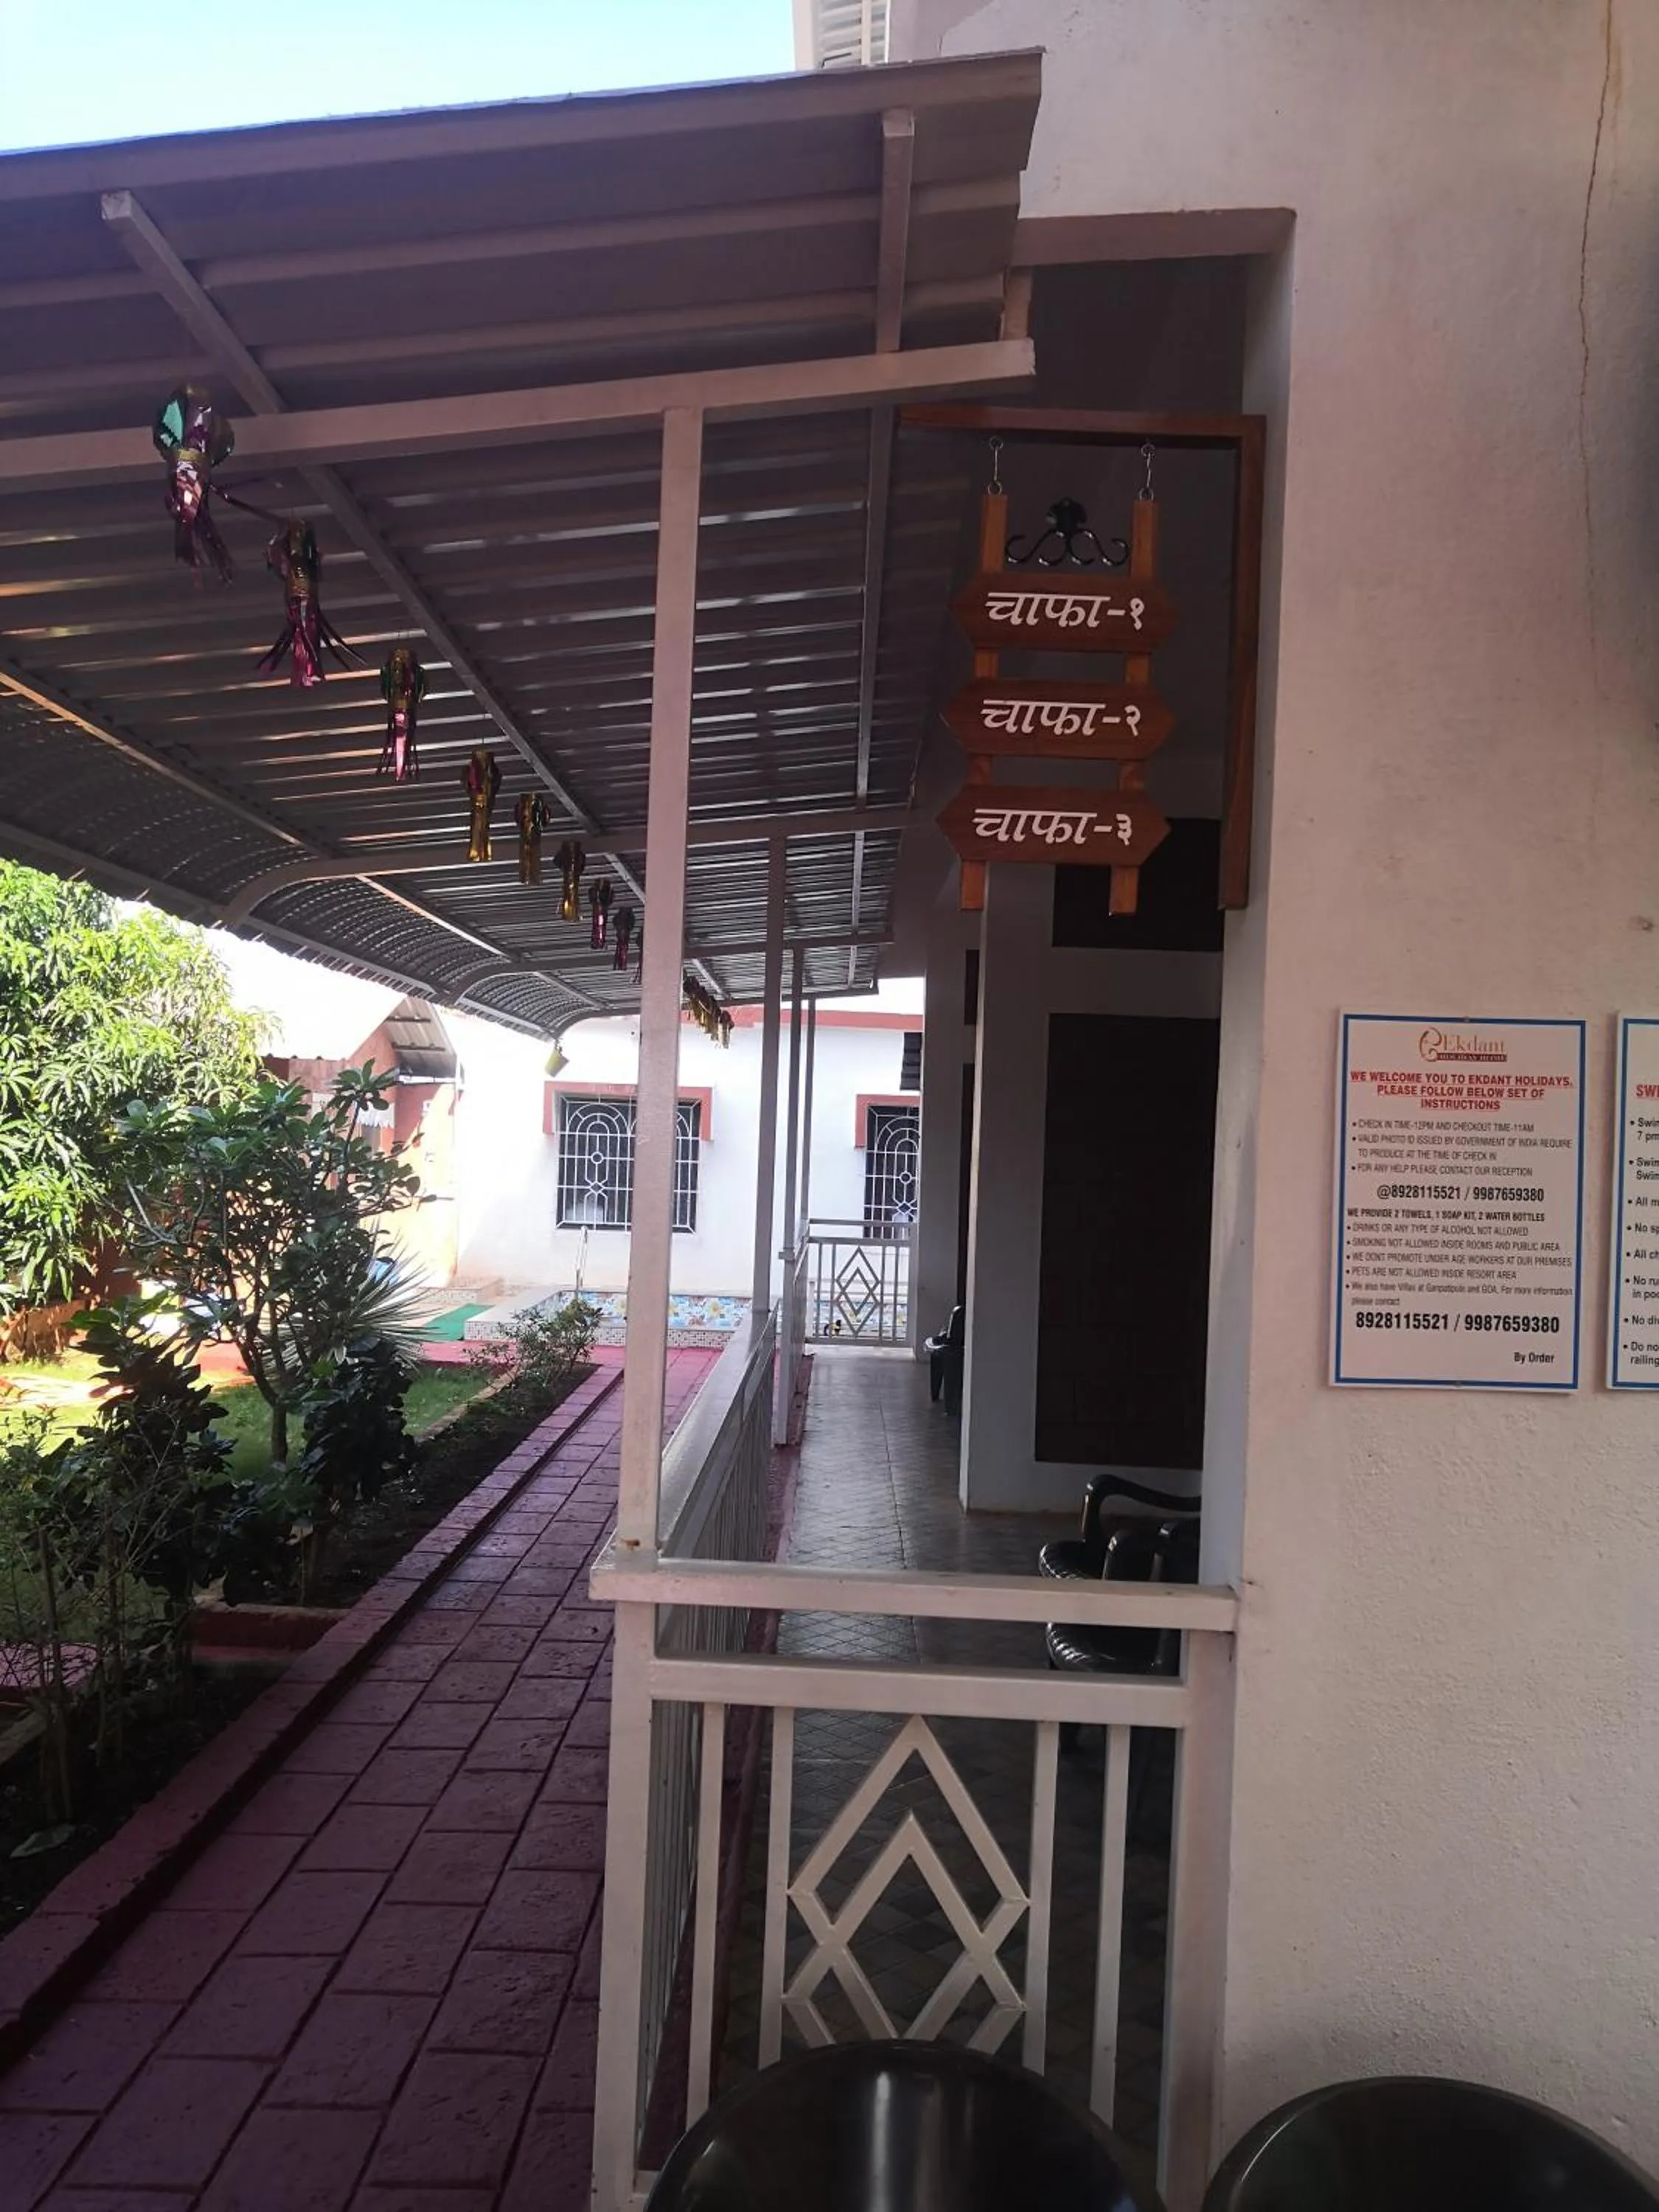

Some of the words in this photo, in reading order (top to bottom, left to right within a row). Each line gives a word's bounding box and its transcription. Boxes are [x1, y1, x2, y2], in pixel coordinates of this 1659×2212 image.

[985, 592, 1145, 630] चाफा-१
[980, 700, 1141, 736] चाफा-२
[972, 808, 1133, 846] चाफा-३
[1351, 1071, 1366, 1081] WE
[1370, 1072, 1422, 1082] WELCOME
[1425, 1074, 1447, 1084] YOU
[1451, 1074, 1465, 1084] TO
[1469, 1075, 1512, 1085] EKDANT
[1515, 1076, 1573, 1086] HOLIDAYS.
[1377, 1085, 1417, 1095] PLEASE
[1421, 1086, 1464, 1096] FOLLOW
[1467, 1088, 1504, 1097] BELOW
[1507, 1088, 1527, 1098] SET
[1531, 1089, 1545, 1099] OF
[1422, 1099, 1500, 1110] INSTRUCTIONS
[1358, 1119, 1382, 1128] CHECK
[1385, 1120, 1393, 1129] IN
[1436, 1121, 1451, 1130] AND
[1453, 1121, 1492, 1132] CHECKOUT
[1494, 1123, 1534, 1133] TIME-11AM
[1358, 1134, 1379, 1143] VALID
[1381, 1135, 1405, 1144] PHOTO
[1408, 1135, 1415, 1144] ID
[1416, 1135, 1442, 1144] ISSUED
[1445, 1136, 1454, 1145] BY
[1455, 1136, 1505, 1147] GOVERNMENT
[1508, 1138, 1518, 1147] OF
[1519, 1138, 1539, 1147] INDIA
[1540, 1138, 1572, 1148] REQUIRE
[1358, 1148, 1368, 1158] TO
[1370, 1149, 1404, 1158] PRODUCE
[1407, 1150, 1416, 1158] AT
[1418, 1150, 1431, 1159] THE
[1433, 1150, 1449, 1159] TIME
[1452, 1150, 1461, 1160] OF
[1463, 1151, 1486, 1161] CHECK
[1489, 1152, 1496, 1161] IN
[1358, 1163, 1371, 1172] FOR
[1374, 1164, 1388, 1172] ANY
[1391, 1164, 1409, 1173] HELP
[1411, 1165, 1437, 1174] PLEASE
[1439, 1165, 1472, 1175] CONTACT
[1475, 1166, 1490, 1175] OUR
[1492, 1167, 1533, 1177] RECEPTION
[1377, 1185, 1461, 1200] @8928115521
[1473, 1186, 1545, 1201] 9987659380
[1635, 1197, 1648, 1206] All
[1348, 1208, 1358, 1217] WE
[1361, 1208, 1392, 1217] PROVIDE
[1441, 1210, 1461, 1219] SOAP
[1478, 1211, 1483, 1220] 2
[1485, 1211, 1511, 1221] WATER
[1512, 1212, 1545, 1222] BOTTLES
[1352, 1222, 1380, 1232] DRINKS
[1382, 1223, 1392, 1232] OR
[1394, 1224, 1408, 1233] ANY
[1411, 1224, 1428, 1234] TYPE
[1430, 1225, 1439, 1234] OF
[1441, 1225, 1475, 1235] ALCOHOL
[1477, 1226, 1492, 1235] NOT
[1494, 1226, 1528, 1237] ALLOWED
[1635, 1222, 1647, 1232] No
[1352, 1237, 1386, 1247] SMOKING
[1388, 1238, 1402, 1247] NOT
[1405, 1239, 1439, 1248] ALLOWED
[1441, 1239, 1464, 1249] INSIDE
[1467, 1240, 1493, 1250] ROOMS
[1495, 1241, 1510, 1250] AND
[1512, 1242, 1539, 1251] PUBLIC
[1540, 1242, 1560, 1251] AREA
[1352, 1252, 1364, 1262] WE
[1387, 1253, 1422, 1262] PROMOTE
[1425, 1254, 1450, 1263] UNDER
[1451, 1254, 1466, 1264] AGE
[1468, 1255, 1504, 1265] WORKERS
[1506, 1256, 1515, 1265] AT
[1517, 1256, 1533, 1266] OUR
[1534, 1256, 1573, 1267] PREMISES
[1634, 1249, 1646, 1258] All
[1352, 1266, 1370, 1276] PETS
[1372, 1267, 1387, 1276] ARE
[1388, 1267, 1403, 1276] NOT
[1405, 1267, 1439, 1277] ALLOWED
[1441, 1268, 1464, 1278] INSIDE
[1467, 1269, 1495, 1279] RESORT
[1497, 1270, 1517, 1279] AREA
[1633, 1276, 1646, 1284] No
[1356, 1312, 1449, 1329] 8928115521
[1464, 1314, 1560, 1333] 9987659380
[1632, 1315, 1644, 1324] No
[1631, 1341, 1644, 1351] Do
[1514, 1352, 1526, 1364] By
[1528, 1352, 1555, 1364] Order
